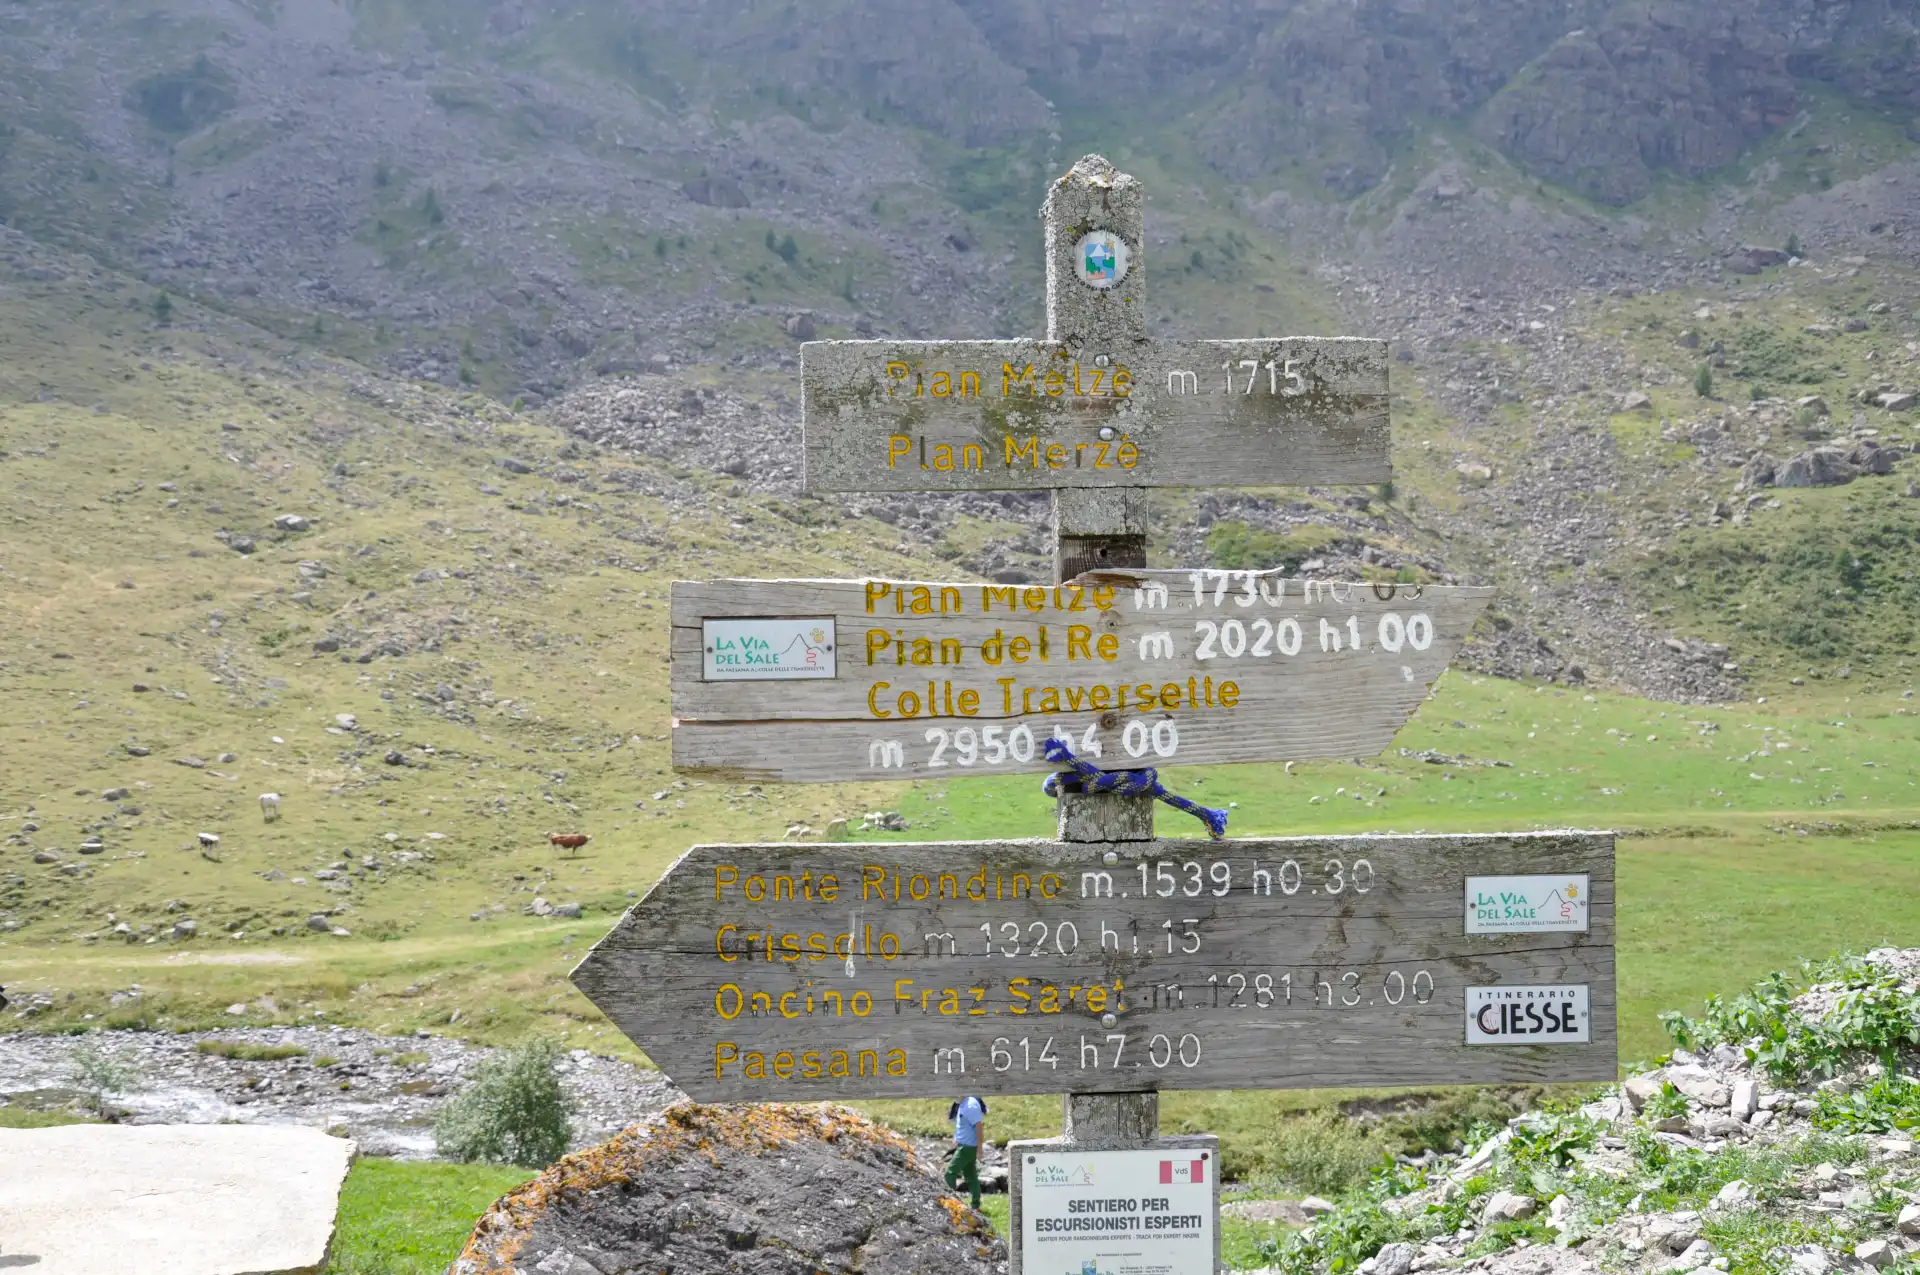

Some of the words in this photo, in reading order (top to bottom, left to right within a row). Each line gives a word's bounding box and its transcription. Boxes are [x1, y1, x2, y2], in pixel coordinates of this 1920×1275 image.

[887, 361, 980, 397] Pian
[1222, 359, 1307, 395] 1715
[865, 580, 962, 613] Pian
[865, 628, 962, 666] Pian
[980, 625, 1049, 665] del
[1067, 624, 1119, 661] Re
[1195, 617, 1302, 661] 2020
[868, 680, 980, 719] Colle
[997, 674, 1240, 715] Traversette
[924, 723, 1036, 767] 2950
[714, 864, 841, 901] Ponte
[862, 863, 1062, 901] Riondino
[715, 923, 901, 962] Crissolo
[979, 920, 1079, 958] 1320
[715, 980, 873, 1020] Oncino
[1478, 990, 1576, 1000] ITINERARIO
[1476, 1001, 1579, 1036] CIESSE
[714, 1041, 908, 1079] Paesana
[990, 1035, 1060, 1072] 614
[1175, 1167, 1189, 1175] VdS
[1035, 1216, 1140, 1232] ESCURSIONISTI
[1145, 1214, 1202, 1230] ESPERTI
[1068, 1198, 1138, 1214] SENTIERO
[1141, 1197, 1170, 1212] PER
